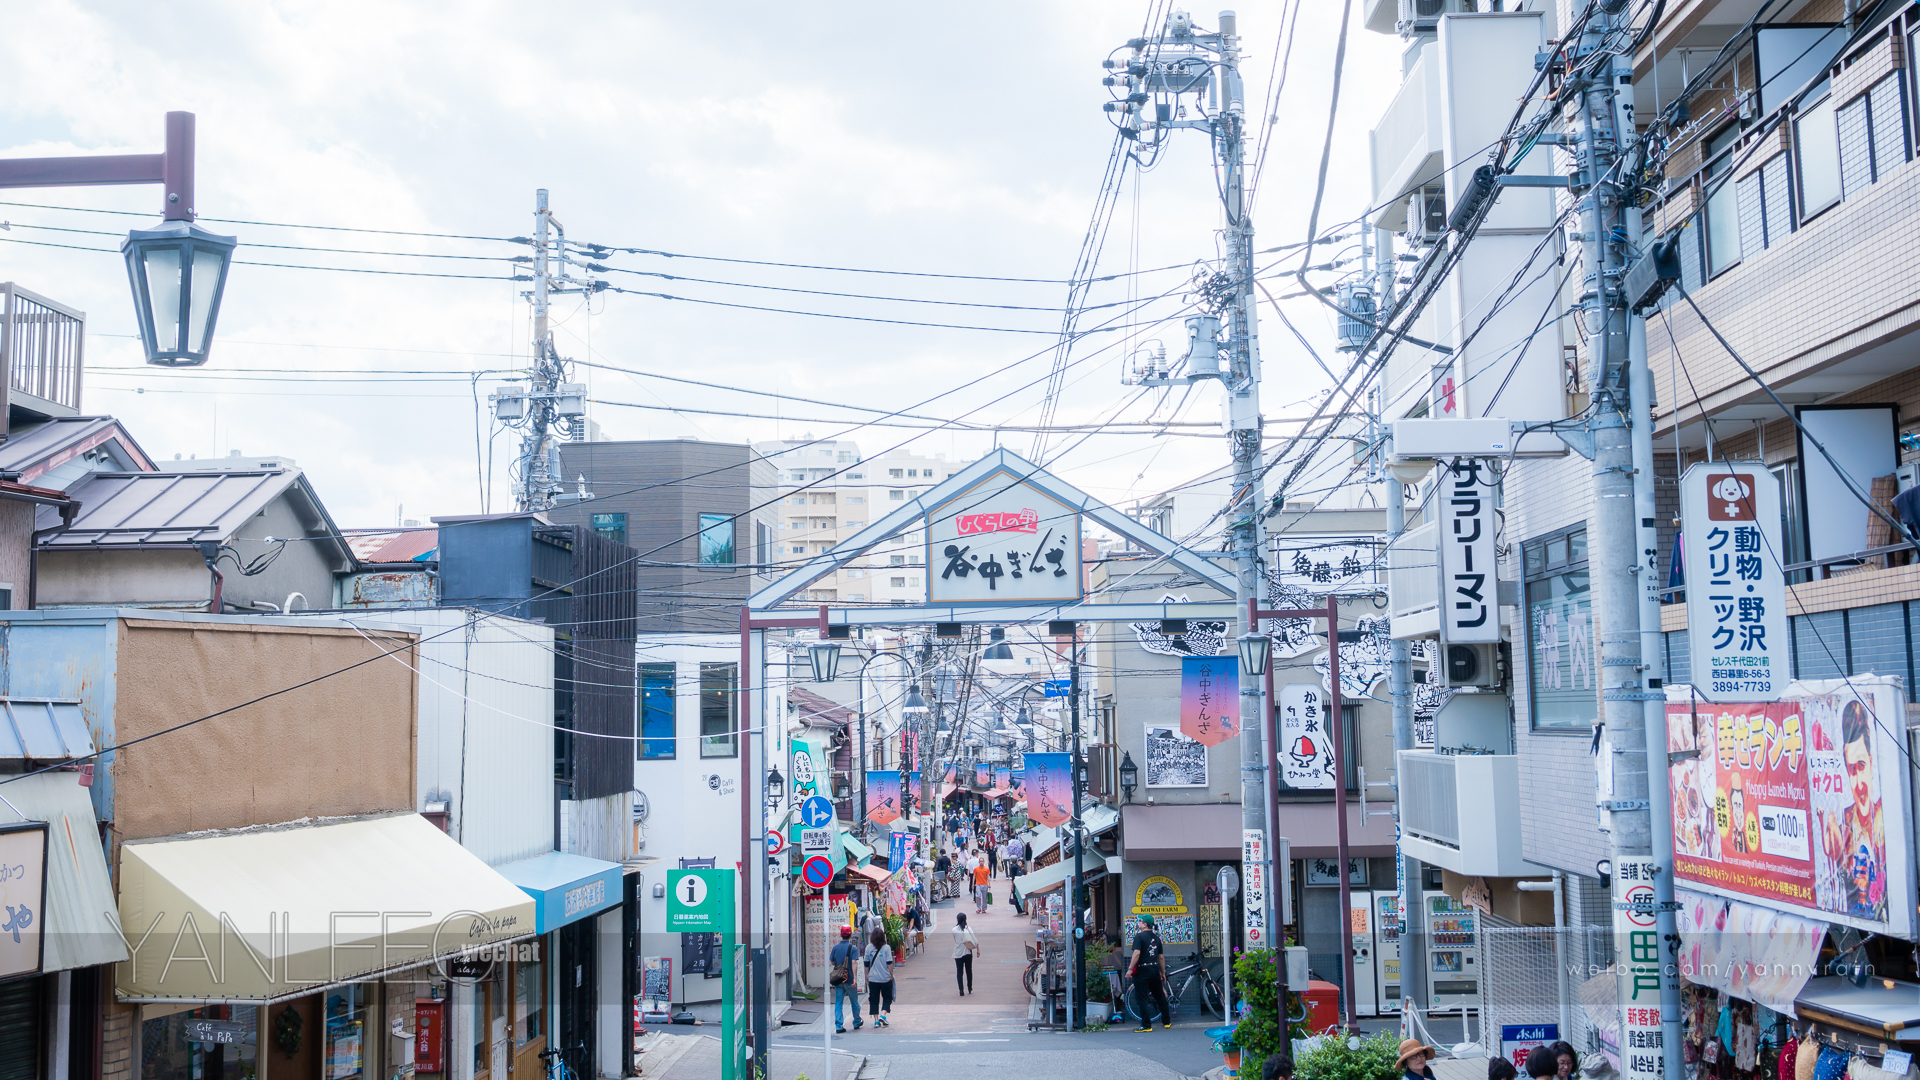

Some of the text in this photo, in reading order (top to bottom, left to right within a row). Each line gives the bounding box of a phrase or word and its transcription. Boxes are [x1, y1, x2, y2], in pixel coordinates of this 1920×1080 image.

[957, 508, 1038, 534] ひぐらしの里
[1451, 458, 1487, 628] サラリーマン
[942, 528, 1067, 590] 谷中ぎんざ
[1706, 527, 1735, 650] クリニック
[1734, 526, 1767, 651] 動物・野沢
[1711, 656, 1770, 667] セレス千代田21前
[1711, 669, 1770, 679] 西日暮里6-56-3
[1712, 681, 1771, 692] 3894-7739
[1198, 664, 1211, 735] 谷中ぎんざ
[1304, 691, 1318, 732] かき氷
[1717, 712, 1803, 773] 幸せランチ
[1287, 768, 1320, 778] ひみつ堂
[1810, 758, 1841, 768] レストラン
[1038, 763, 1050, 819] 谷中ぎんざ
[1746, 780, 1766, 800] Happy
[1768, 781, 1787, 798] Lunch
[1812, 771, 1843, 794] ザクロ
[1633, 894, 1654, 917] 質
[2, 904, 33, 944] や
[501, 915, 517, 931] papa
[196, 1022, 212, 1032] Café
[1516, 1028, 1544, 1040] Asahi
[420, 1029, 429, 1052] 消火器
